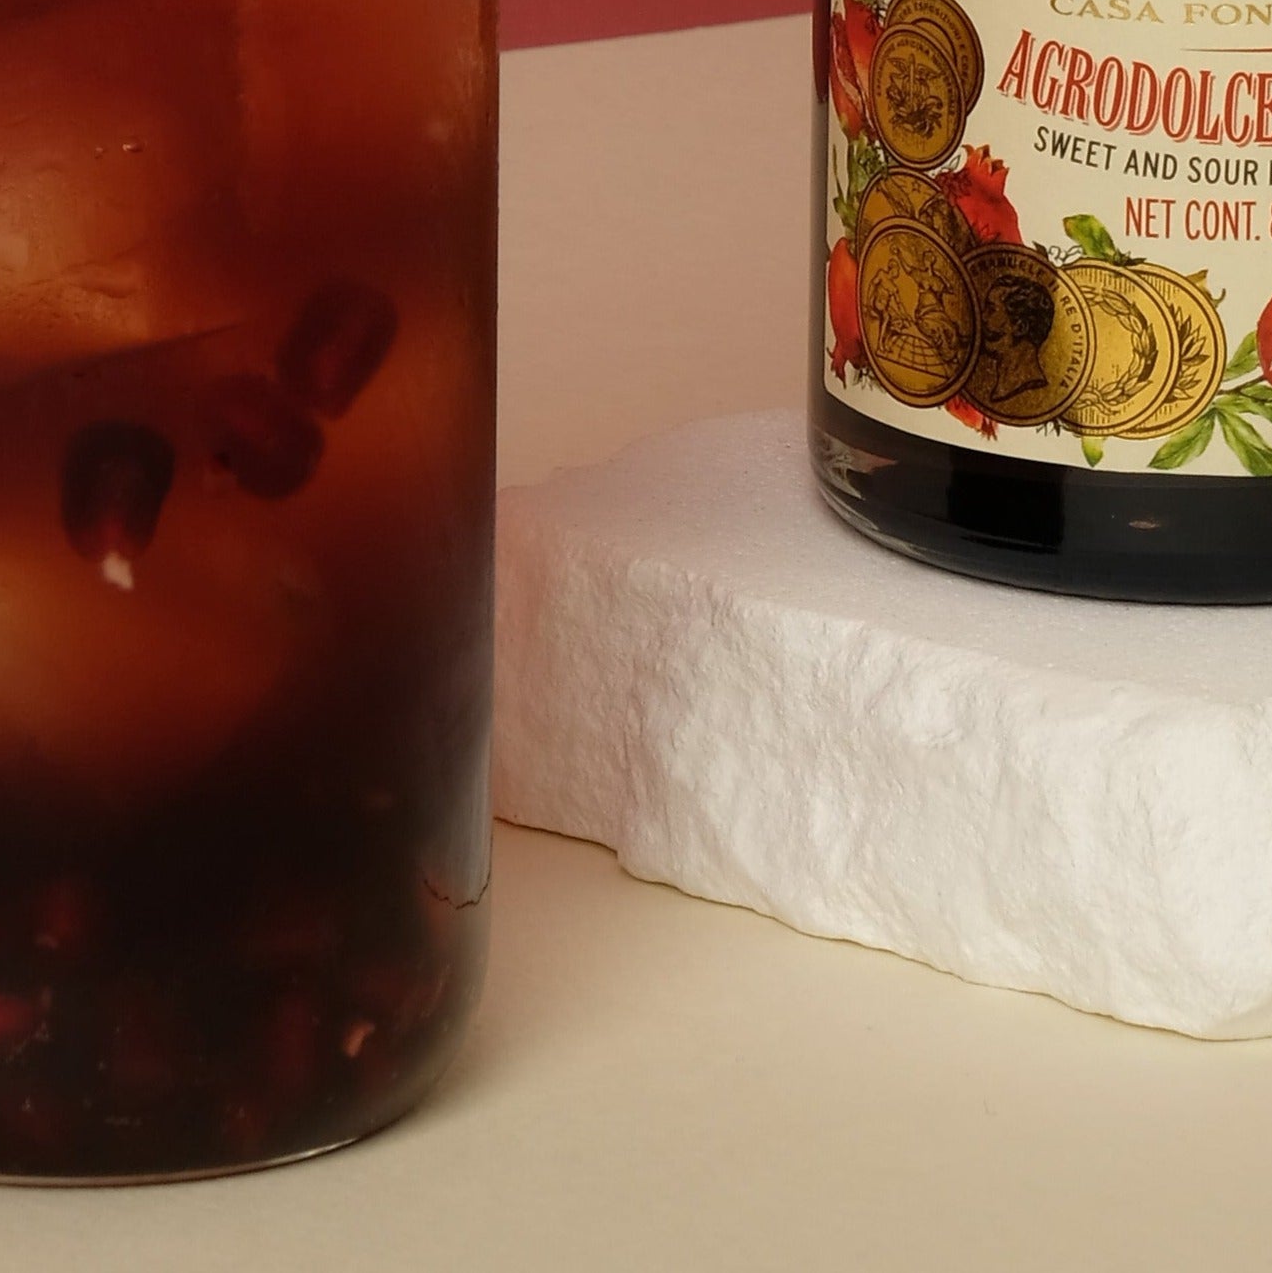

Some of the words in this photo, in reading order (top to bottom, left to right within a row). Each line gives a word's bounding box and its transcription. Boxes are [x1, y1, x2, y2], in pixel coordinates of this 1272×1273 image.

[1033, 126, 1114, 172] SWEET
[1123, 150, 1179, 181] AND
[1188, 156, 1258, 186] SOUR
[1125, 197, 1176, 238] NET
[1184, 199, 1262, 241] CONT.
[1061, 295, 1078, 316] RE
[1059, 323, 1083, 388] D'ITALIA
